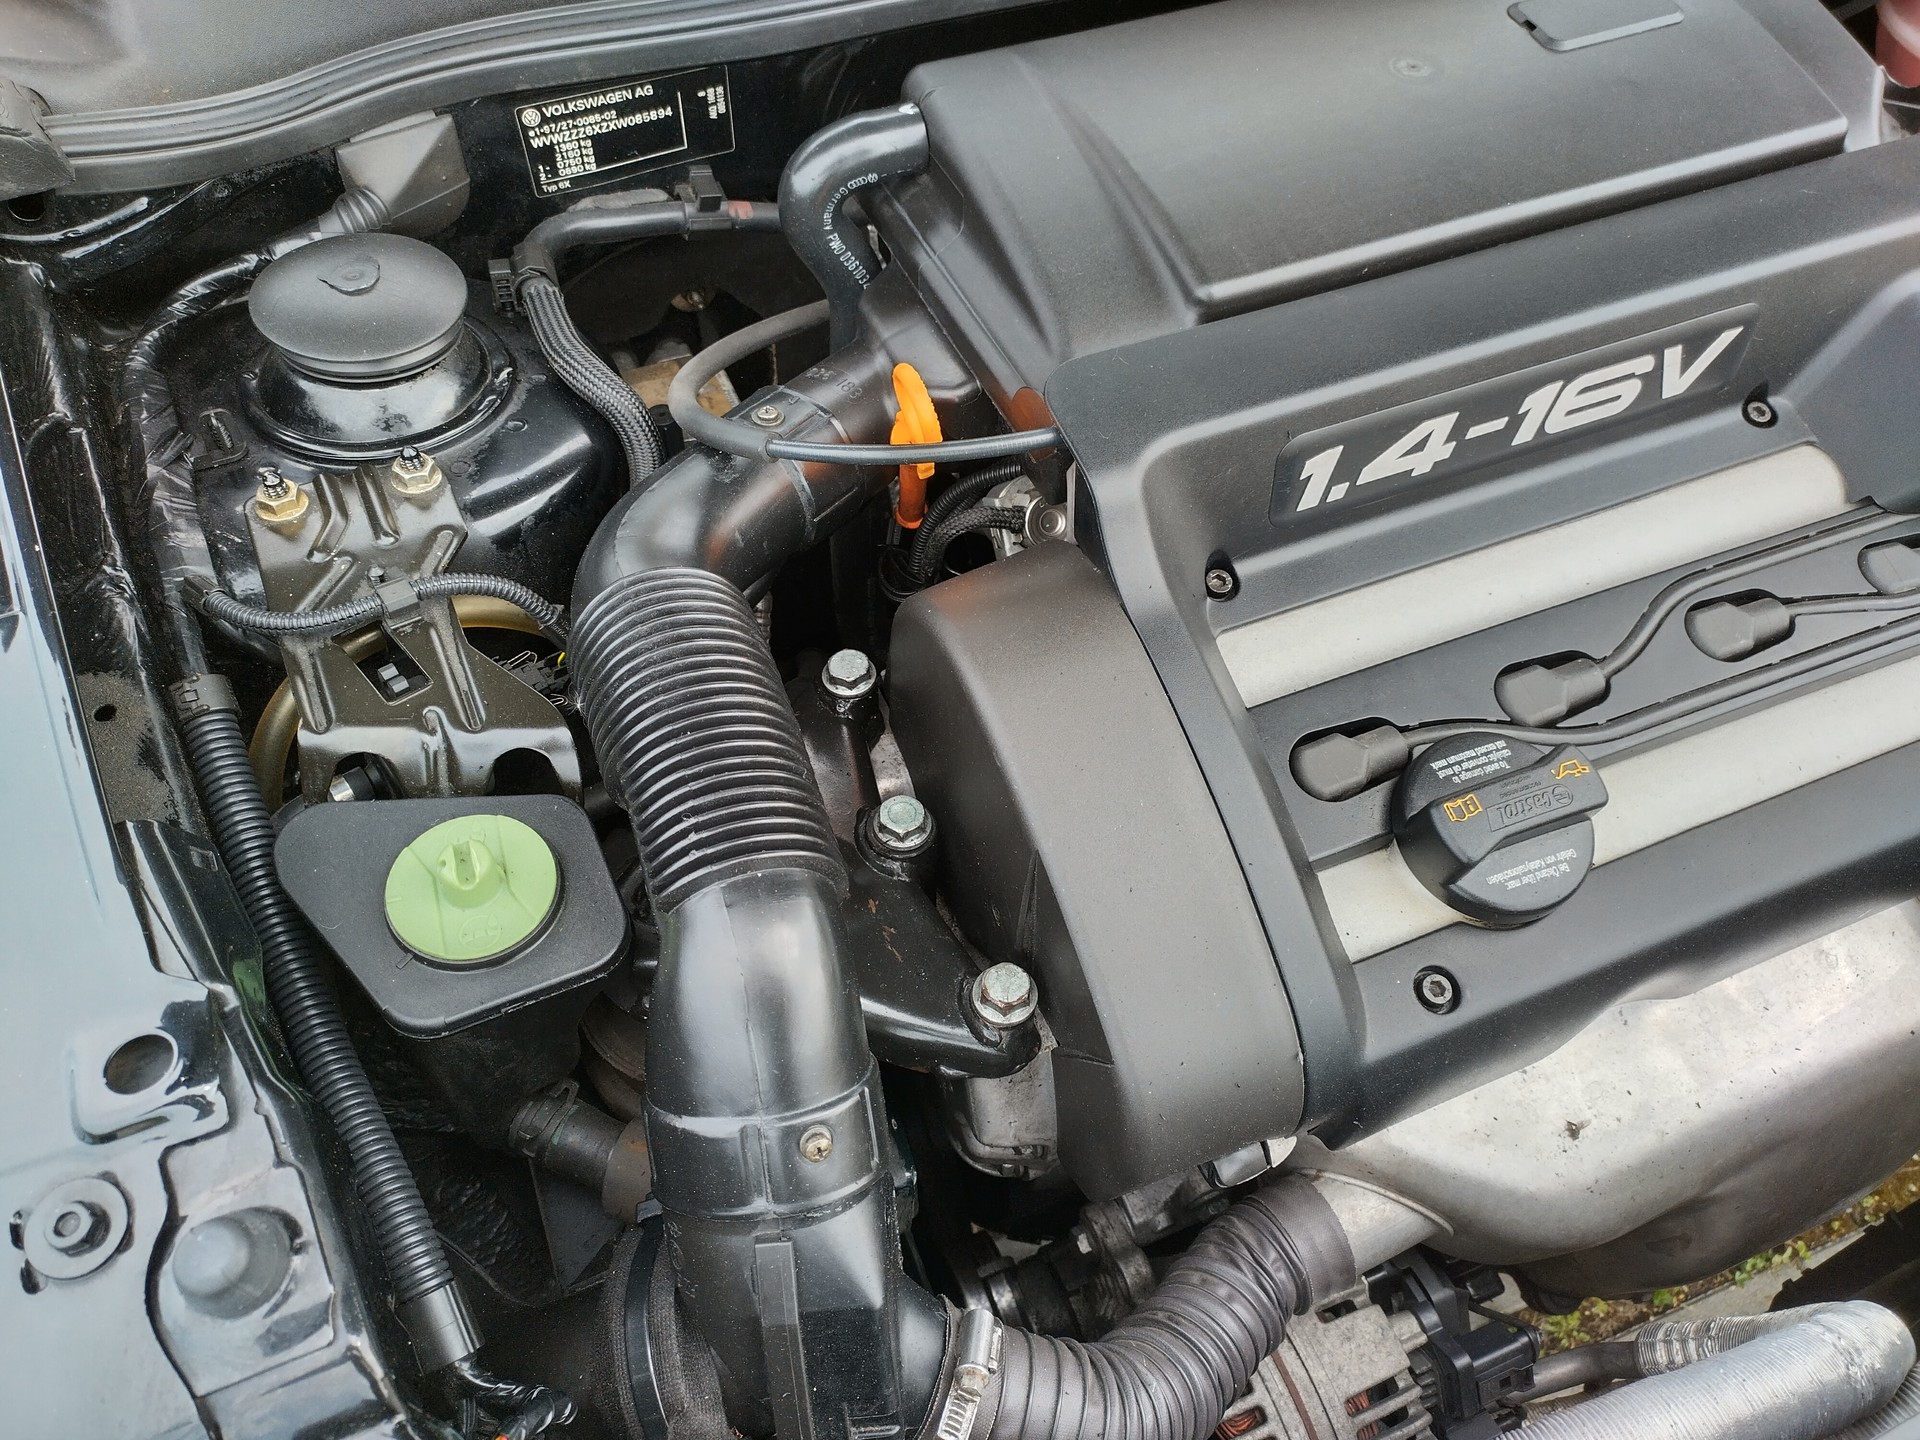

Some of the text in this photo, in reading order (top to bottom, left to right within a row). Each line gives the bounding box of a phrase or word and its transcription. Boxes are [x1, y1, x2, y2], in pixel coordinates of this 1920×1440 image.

[542, 85, 653, 117] VOLKSWAGEN AG
[530, 106, 673, 148] WVWZZZ6XZXW085894
[554, 139, 592, 153] 1360 kg
[555, 147, 593, 161] 2160 kg
[556, 157, 582, 169] 0750
[583, 155, 595, 163] kg
[584, 163, 597, 171] kg
[541, 180, 571, 193] Typ 6X
[823, 187, 848, 230] Germany
[1296, 326, 1744, 512] 1.4-16V
[1474, 743, 1497, 756] exceed
[1446, 749, 1476, 764] maximum
[1430, 758, 1448, 770] mark
[1436, 749, 1512, 779] catalytic converter oil must
[1483, 762, 1501, 774] avoid
[1499, 760, 1511, 769] To
[1459, 767, 1484, 780] damage
[1496, 791, 1551, 824] Castrol
[1544, 855, 1556, 864] von
[1556, 848, 1576, 861] Gefahr
[1558, 862, 1571, 874] Bei
